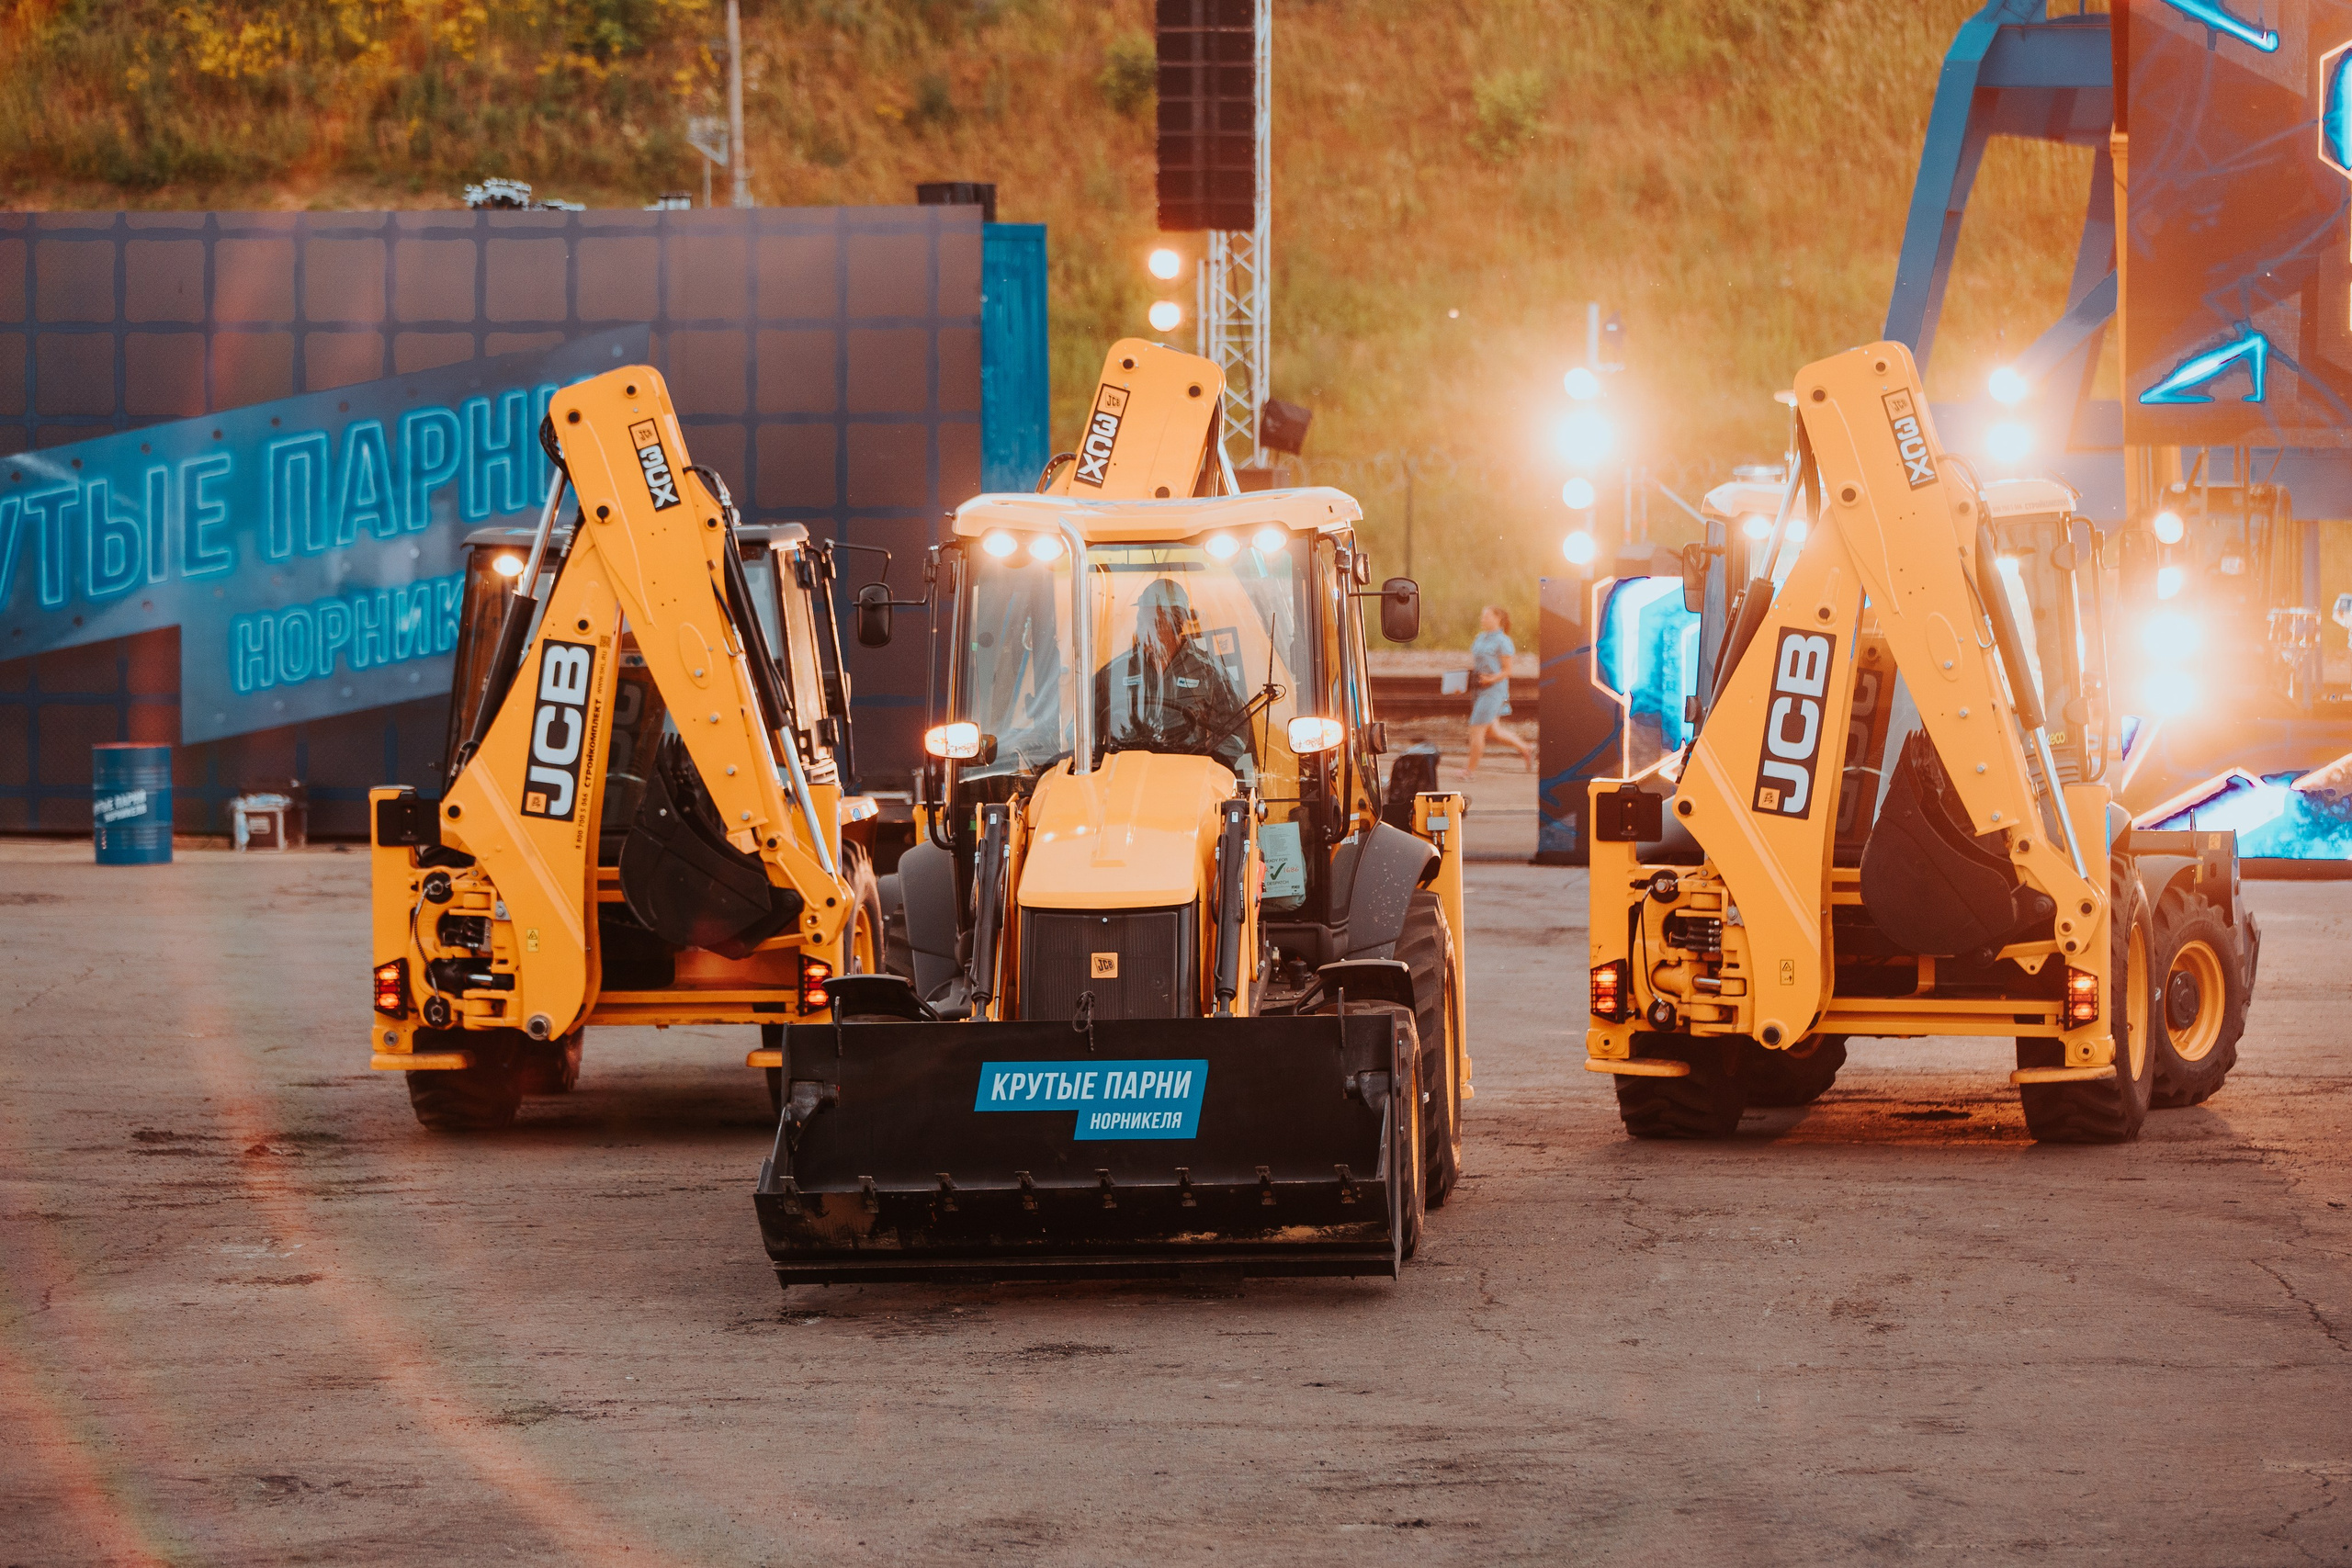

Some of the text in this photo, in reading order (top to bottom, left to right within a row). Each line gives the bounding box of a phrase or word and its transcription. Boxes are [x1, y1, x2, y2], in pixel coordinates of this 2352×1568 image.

[1106, 395, 1121, 407] JCB
[639, 445, 679, 508] 3CX
[1077, 412, 1118, 480] 3CX
[1894, 416, 1935, 482] 3CX
[529, 645, 590, 816] JCB
[584, 699, 602, 788] СТРОЙКОМПЛЕКТ
[1762, 634, 1829, 813] JCB
[1098, 959, 1114, 972] JCB
[990, 1070, 1193, 1101] КРУТЫЕ ПАРНИ
[1090, 1111, 1182, 1130] НОРНИКЕЛЯ
